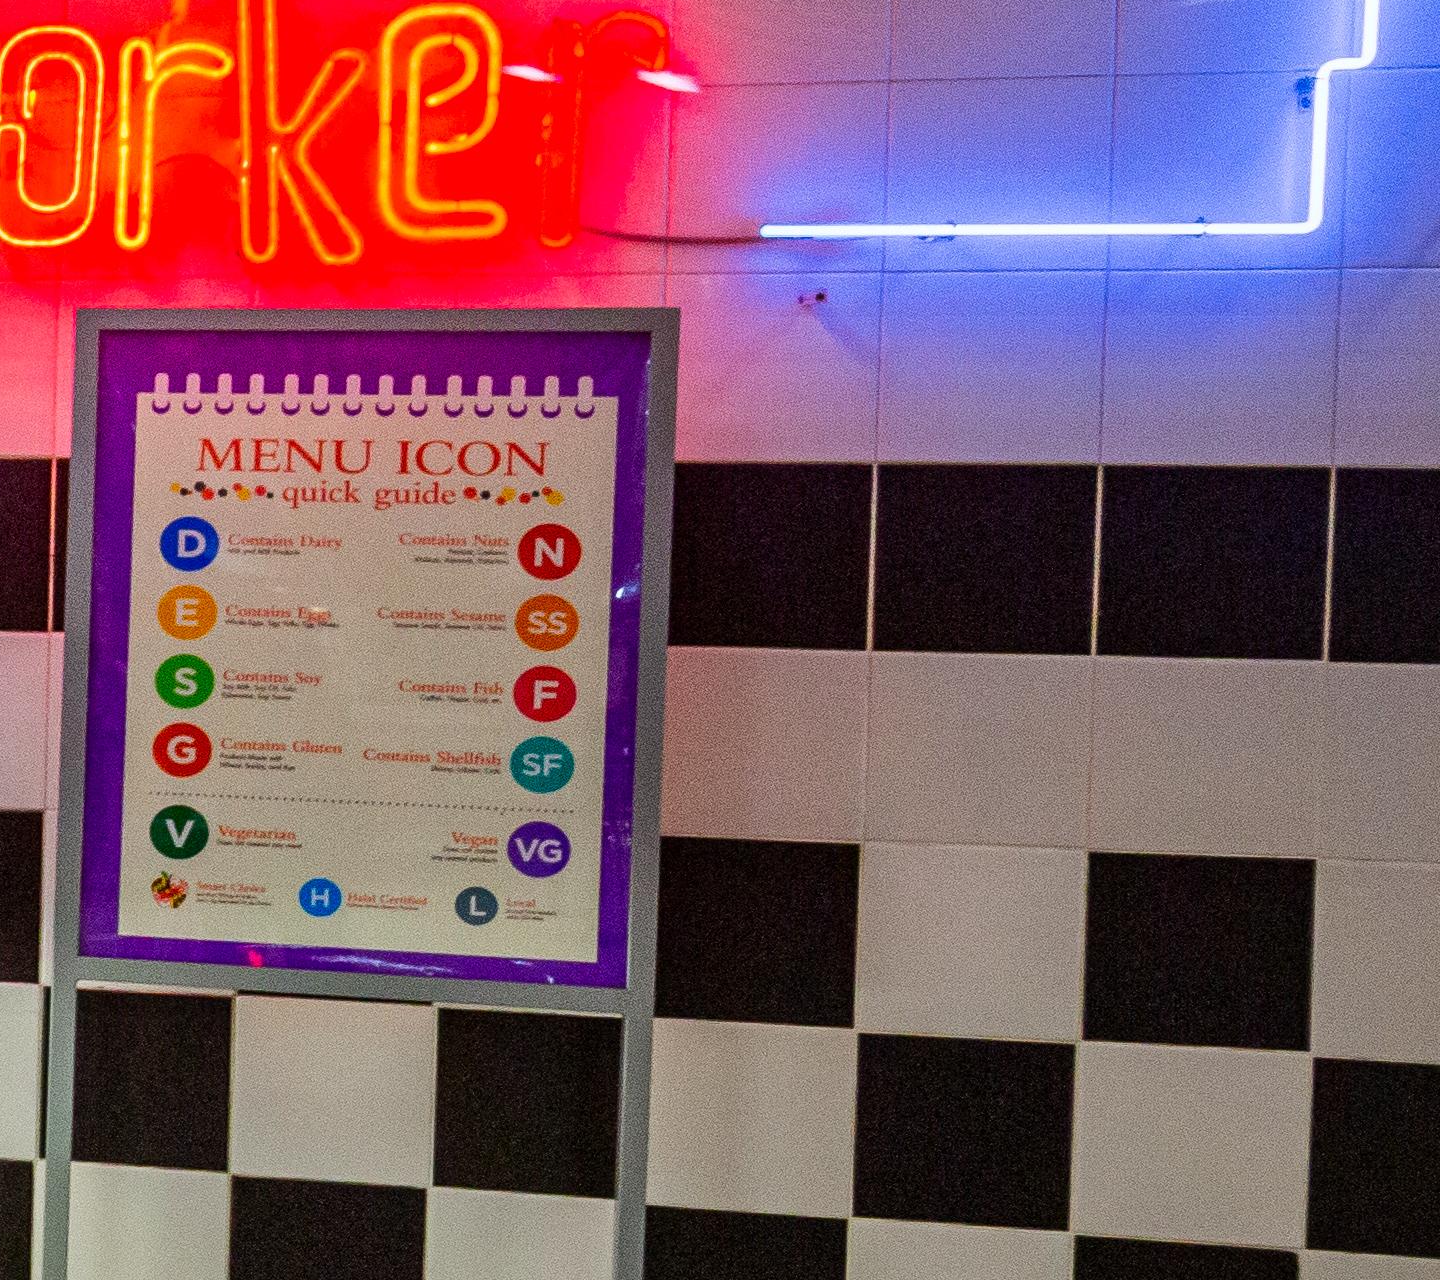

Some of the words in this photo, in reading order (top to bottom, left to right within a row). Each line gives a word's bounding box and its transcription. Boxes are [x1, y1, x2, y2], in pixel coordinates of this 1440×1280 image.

[194, 436, 375, 476] MENU
[395, 438, 551, 478] ICON
[281, 479, 361, 510] quick
[373, 479, 457, 512] guide
[176, 530, 207, 559] D
[227, 533, 294, 548] Contains
[299, 534, 343, 551] Dairy
[397, 531, 468, 547] Contains
[472, 533, 510, 547] Nuts
[533, 537, 565, 567] N
[175, 598, 199, 628] E
[224, 603, 292, 619] Contains
[376, 605, 446, 621] Contains
[450, 607, 507, 623] Sesame
[528, 610, 568, 636] SS
[173, 666, 198, 698] S
[222, 668, 289, 684] Contains
[294, 671, 323, 687] Soy
[397, 678, 468, 694] Contains
[472, 680, 504, 696] Fish
[532, 680, 558, 710] F
[166, 735, 197, 765] G
[219, 736, 287, 753] Contains
[291, 739, 344, 755] Gluten
[361, 747, 432, 764] Contains
[435, 749, 502, 767] Shellfish
[521, 752, 563, 778] SF
[164, 818, 196, 849] V
[216, 824, 297, 842] Vegetarian
[450, 830, 499, 849] Vegan
[513, 837, 564, 864] VG
[310, 887, 330, 908] H
[467, 894, 488, 918] L
